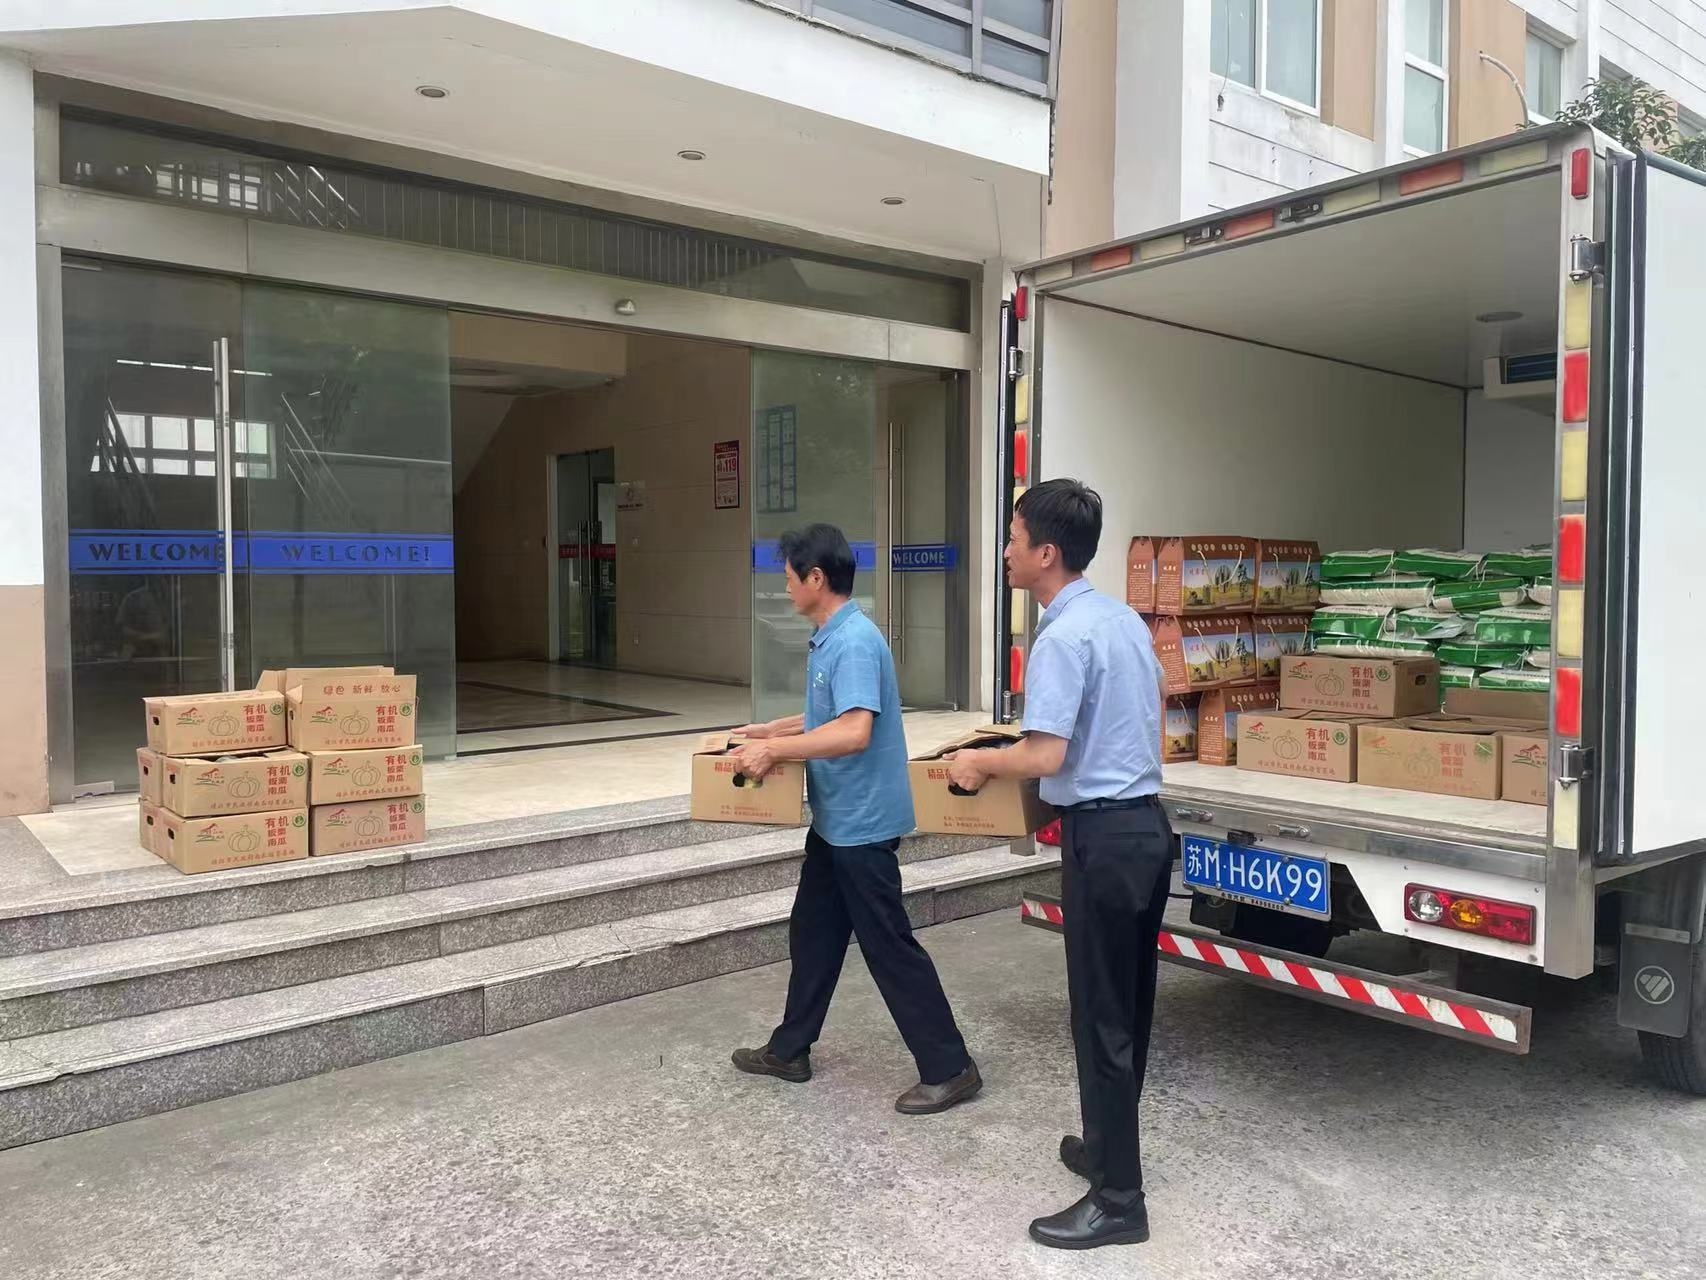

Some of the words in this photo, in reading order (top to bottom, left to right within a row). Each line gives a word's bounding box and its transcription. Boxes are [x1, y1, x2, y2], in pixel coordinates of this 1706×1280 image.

[281, 544, 430, 561] WELCOME!
[893, 552, 944, 564] WELCOME
[1350, 666, 1374, 678] 有机
[353, 685, 373, 694] 新鲜
[1352, 688, 1370, 697] 南瓜
[243, 704, 267, 714] 有机
[376, 705, 398, 715] 有机
[377, 725, 394, 733] 南瓜
[1306, 728, 1330, 741] 有机
[385, 754, 407, 765] 有机
[1308, 751, 1327, 761] 南瓜
[267, 763, 291, 777] 有机
[387, 774, 404, 783] 南瓜
[268, 787, 287, 795] 南瓜
[388, 803, 408, 814] 有机
[265, 817, 289, 828] 有机
[389, 822, 406, 831] 南瓜
[267, 838, 287, 846] 南瓜
